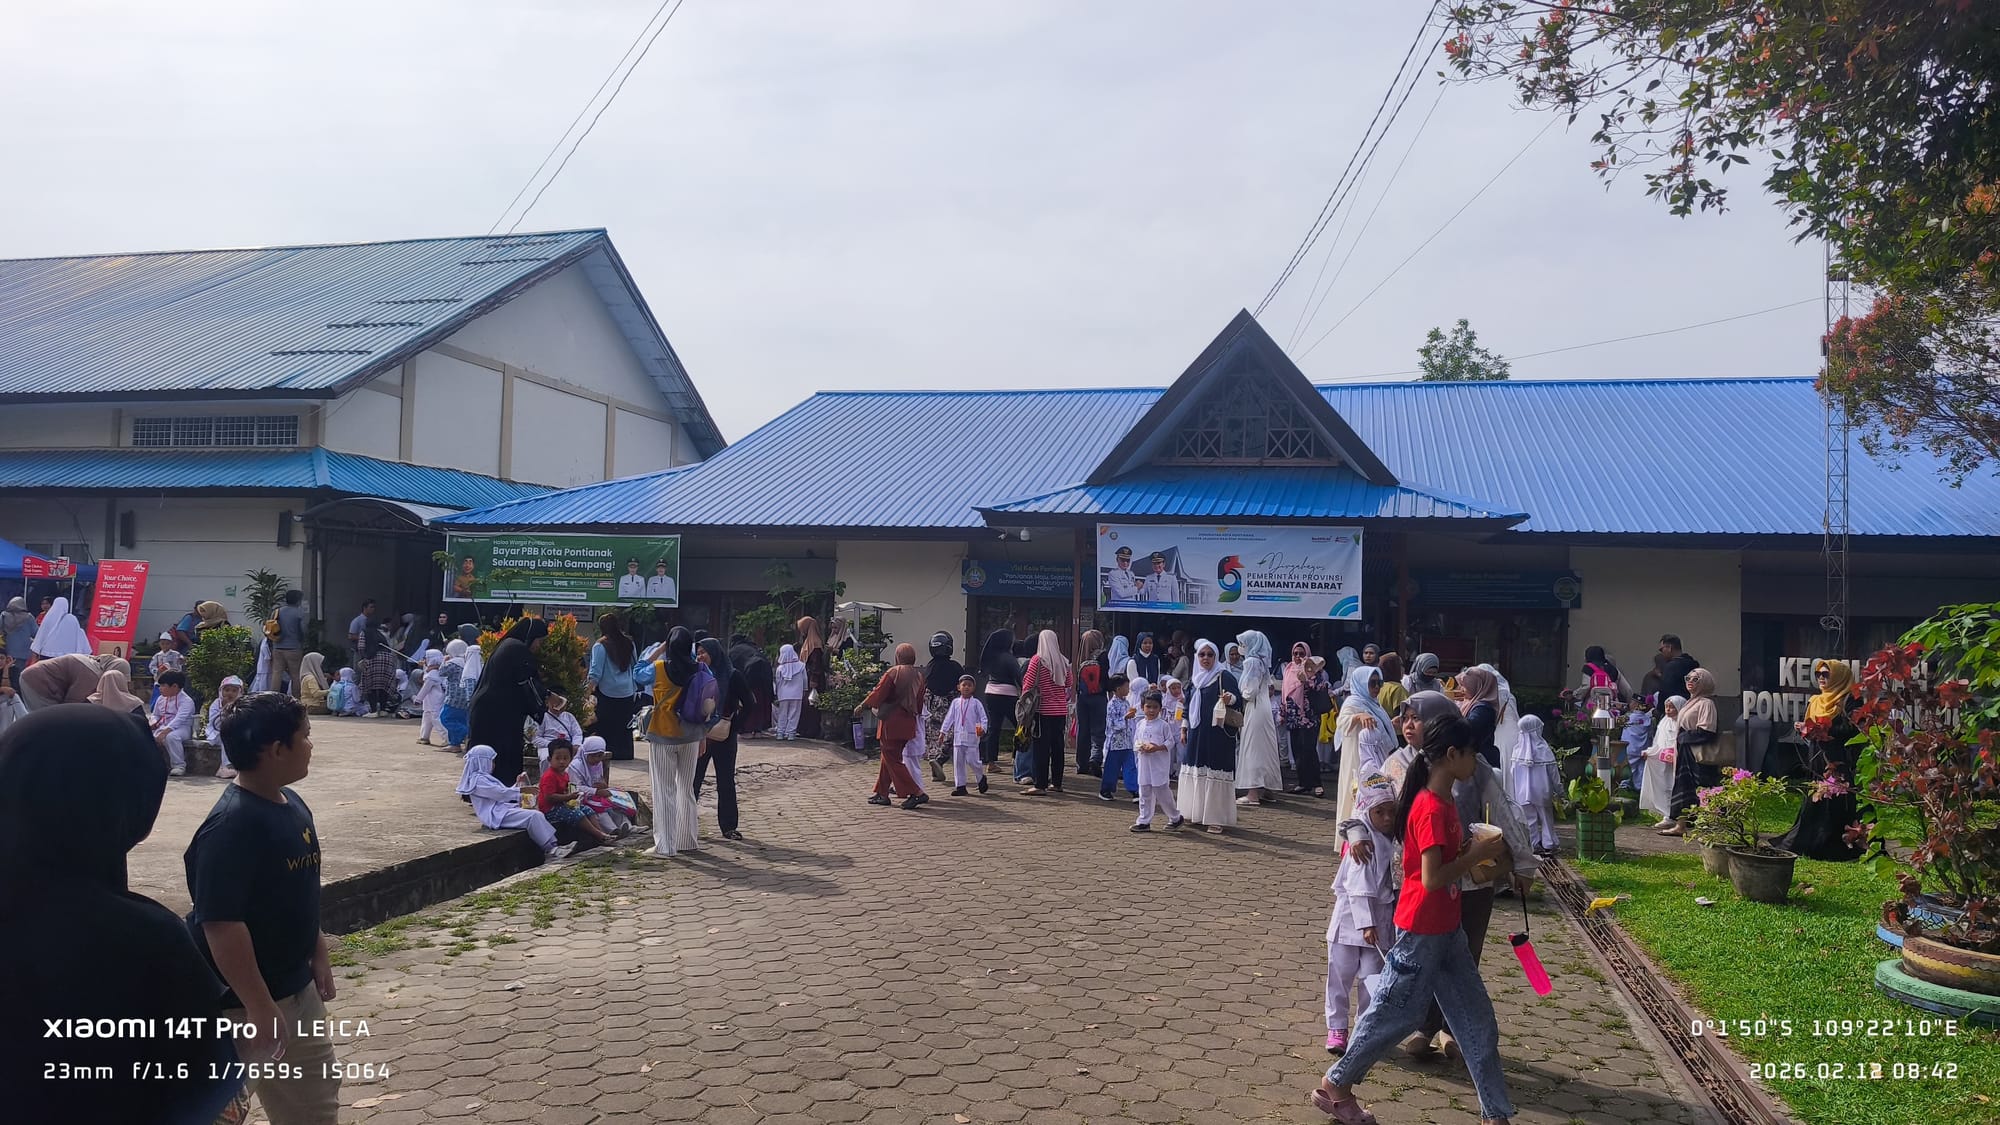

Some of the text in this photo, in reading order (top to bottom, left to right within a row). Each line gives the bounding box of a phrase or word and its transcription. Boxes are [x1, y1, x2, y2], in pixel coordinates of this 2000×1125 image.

[492, 546, 613, 558] Bayar PBB Kota Pontianak
[492, 558, 615, 572] Sekarang Lebih Gampang!
[1246, 572, 1344, 582] PEMERINTAH PROVINSI
[1246, 580, 1344, 590] KALIMANTAN BARAT
